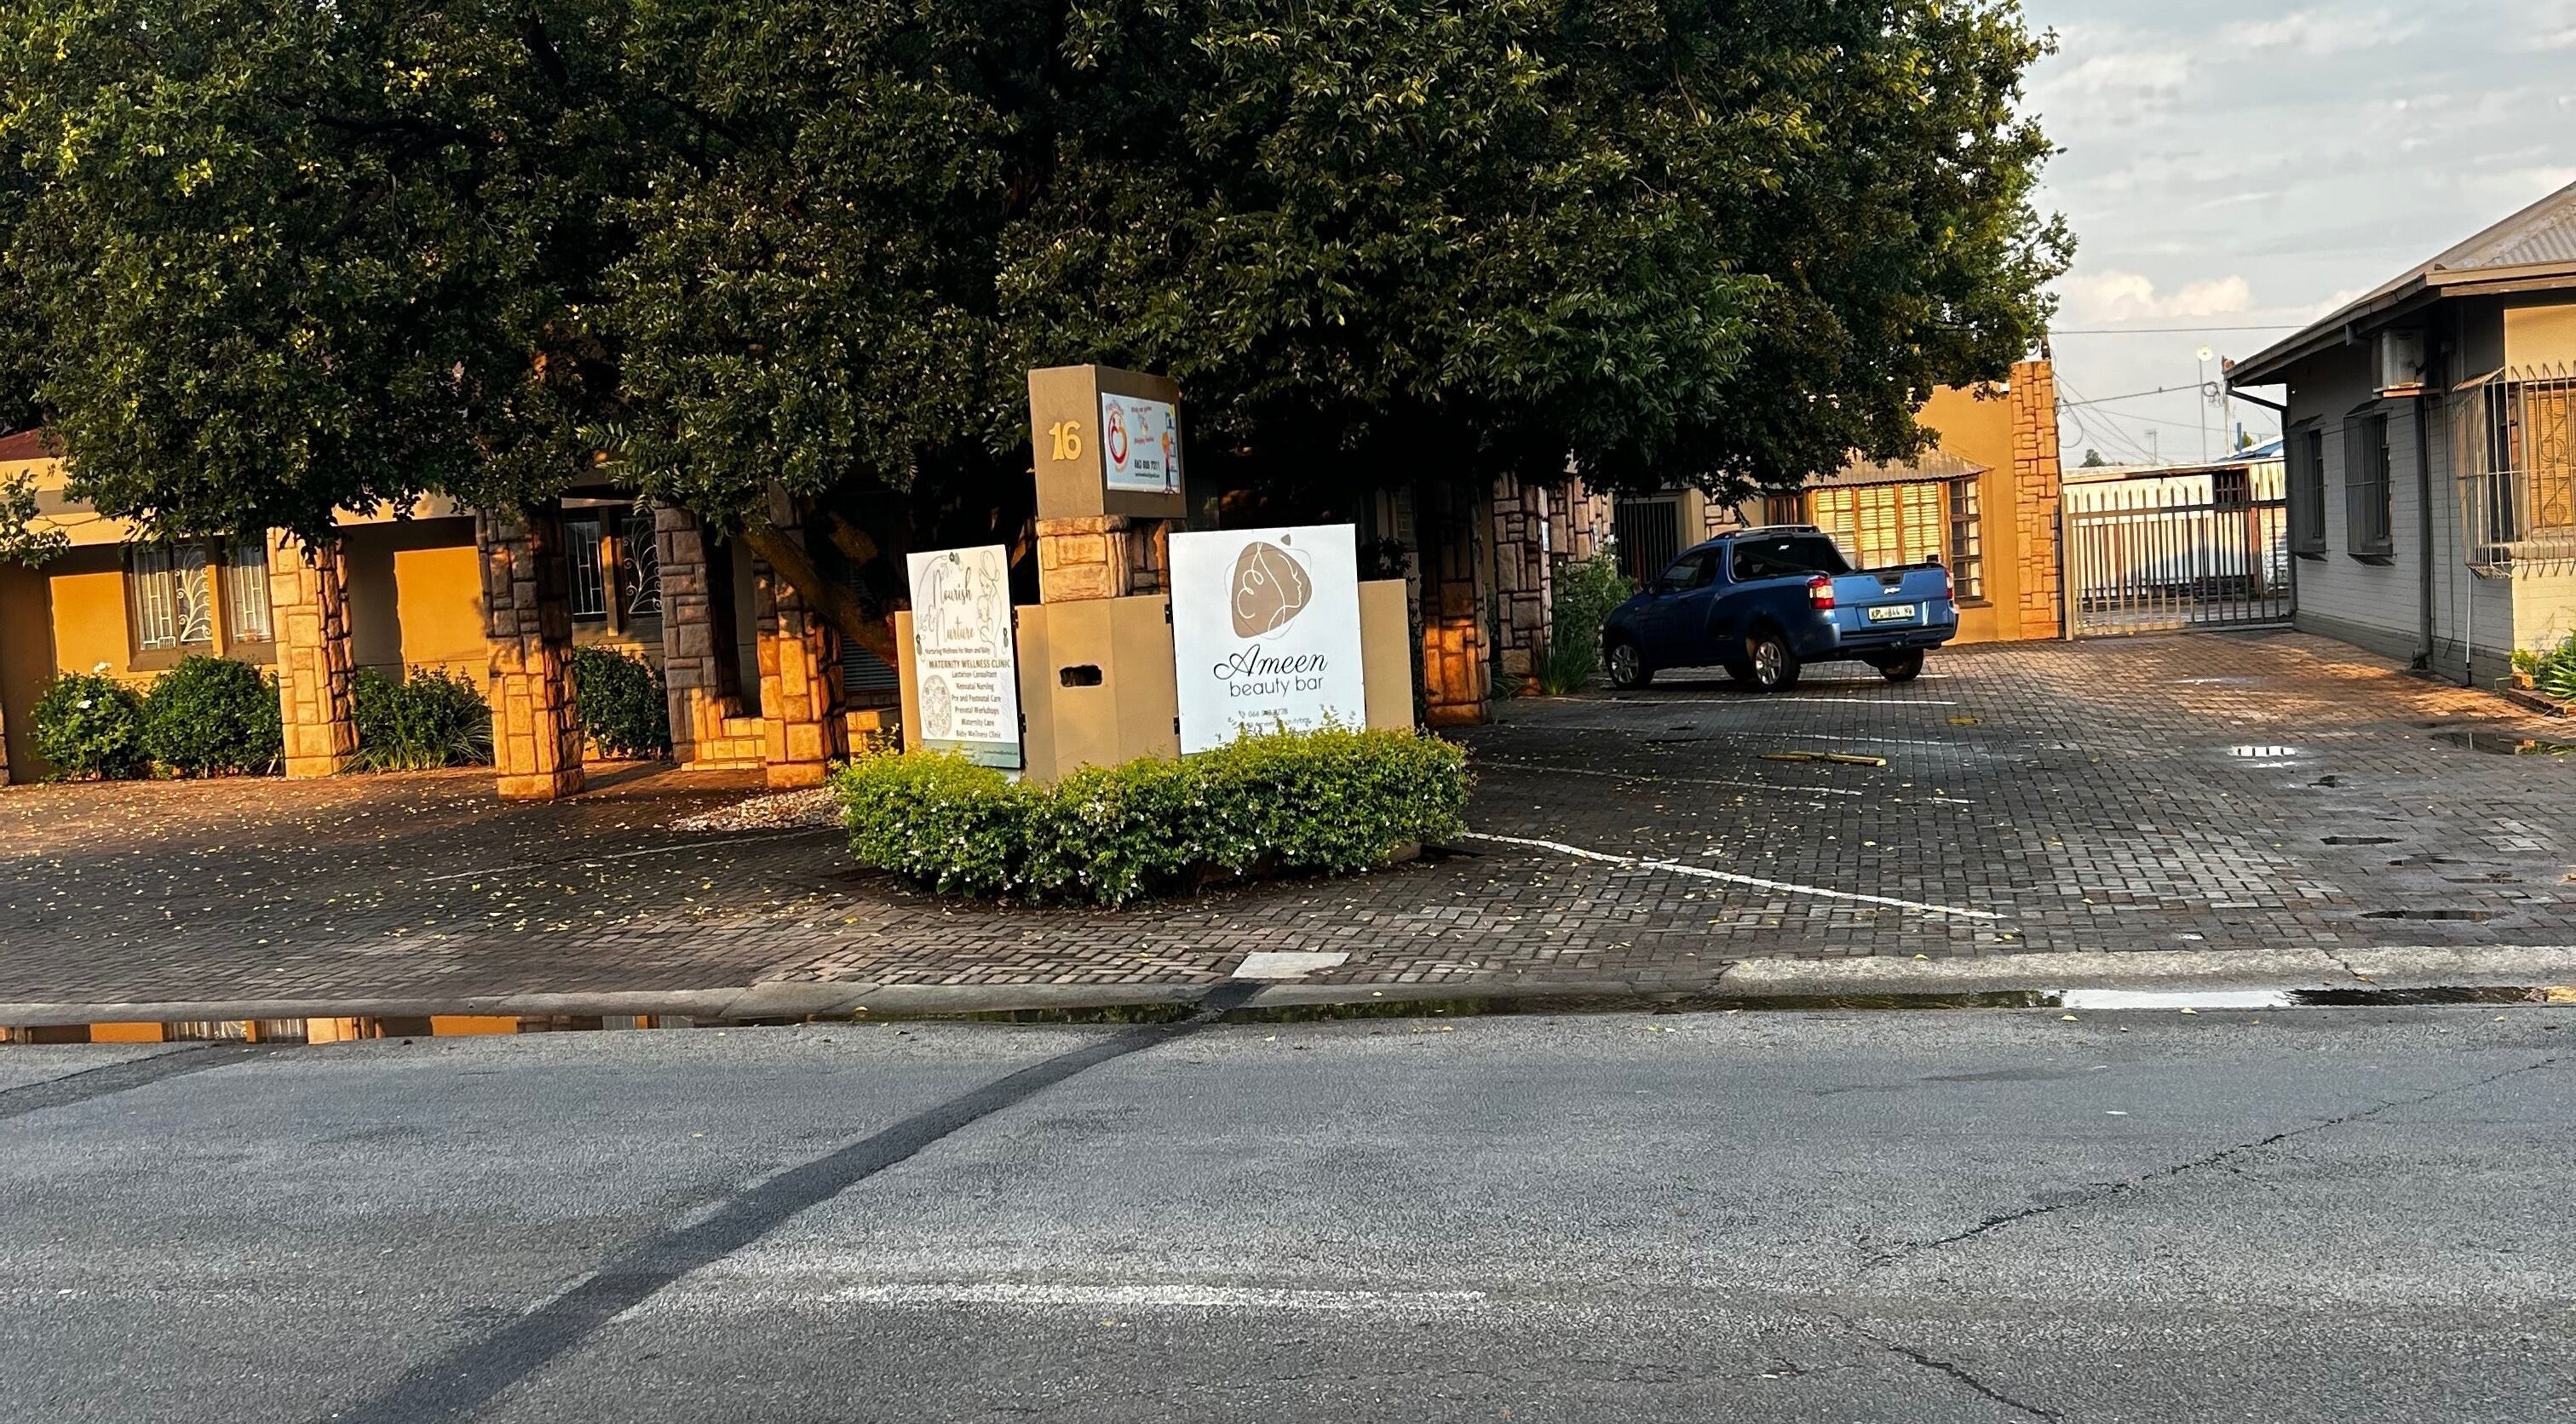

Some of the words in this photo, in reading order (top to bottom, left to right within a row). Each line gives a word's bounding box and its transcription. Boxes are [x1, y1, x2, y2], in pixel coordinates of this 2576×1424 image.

[1049, 421, 1082, 461] 16
[933, 567, 972, 609] Nourish
[936, 608, 975, 647] Nurture
[929, 659, 960, 669] MATERNITY
[961, 659, 990, 669] WELLNESS
[992, 658, 1010, 669] CLINIC
[1213, 643, 1329, 680] Ameen
[976, 682, 994, 692] Nursing
[1230, 678, 1290, 698] beauty
[1295, 675, 1324, 692] bar
[991, 693, 1001, 702] Care
[955, 705, 973, 714] Prenatal
[974, 705, 999, 715] Workshops
[961, 718, 982, 727] Maternity
[984, 718, 994, 726] Care
[968, 730, 987, 738] Wellness
[989, 730, 1001, 738] Clinic
